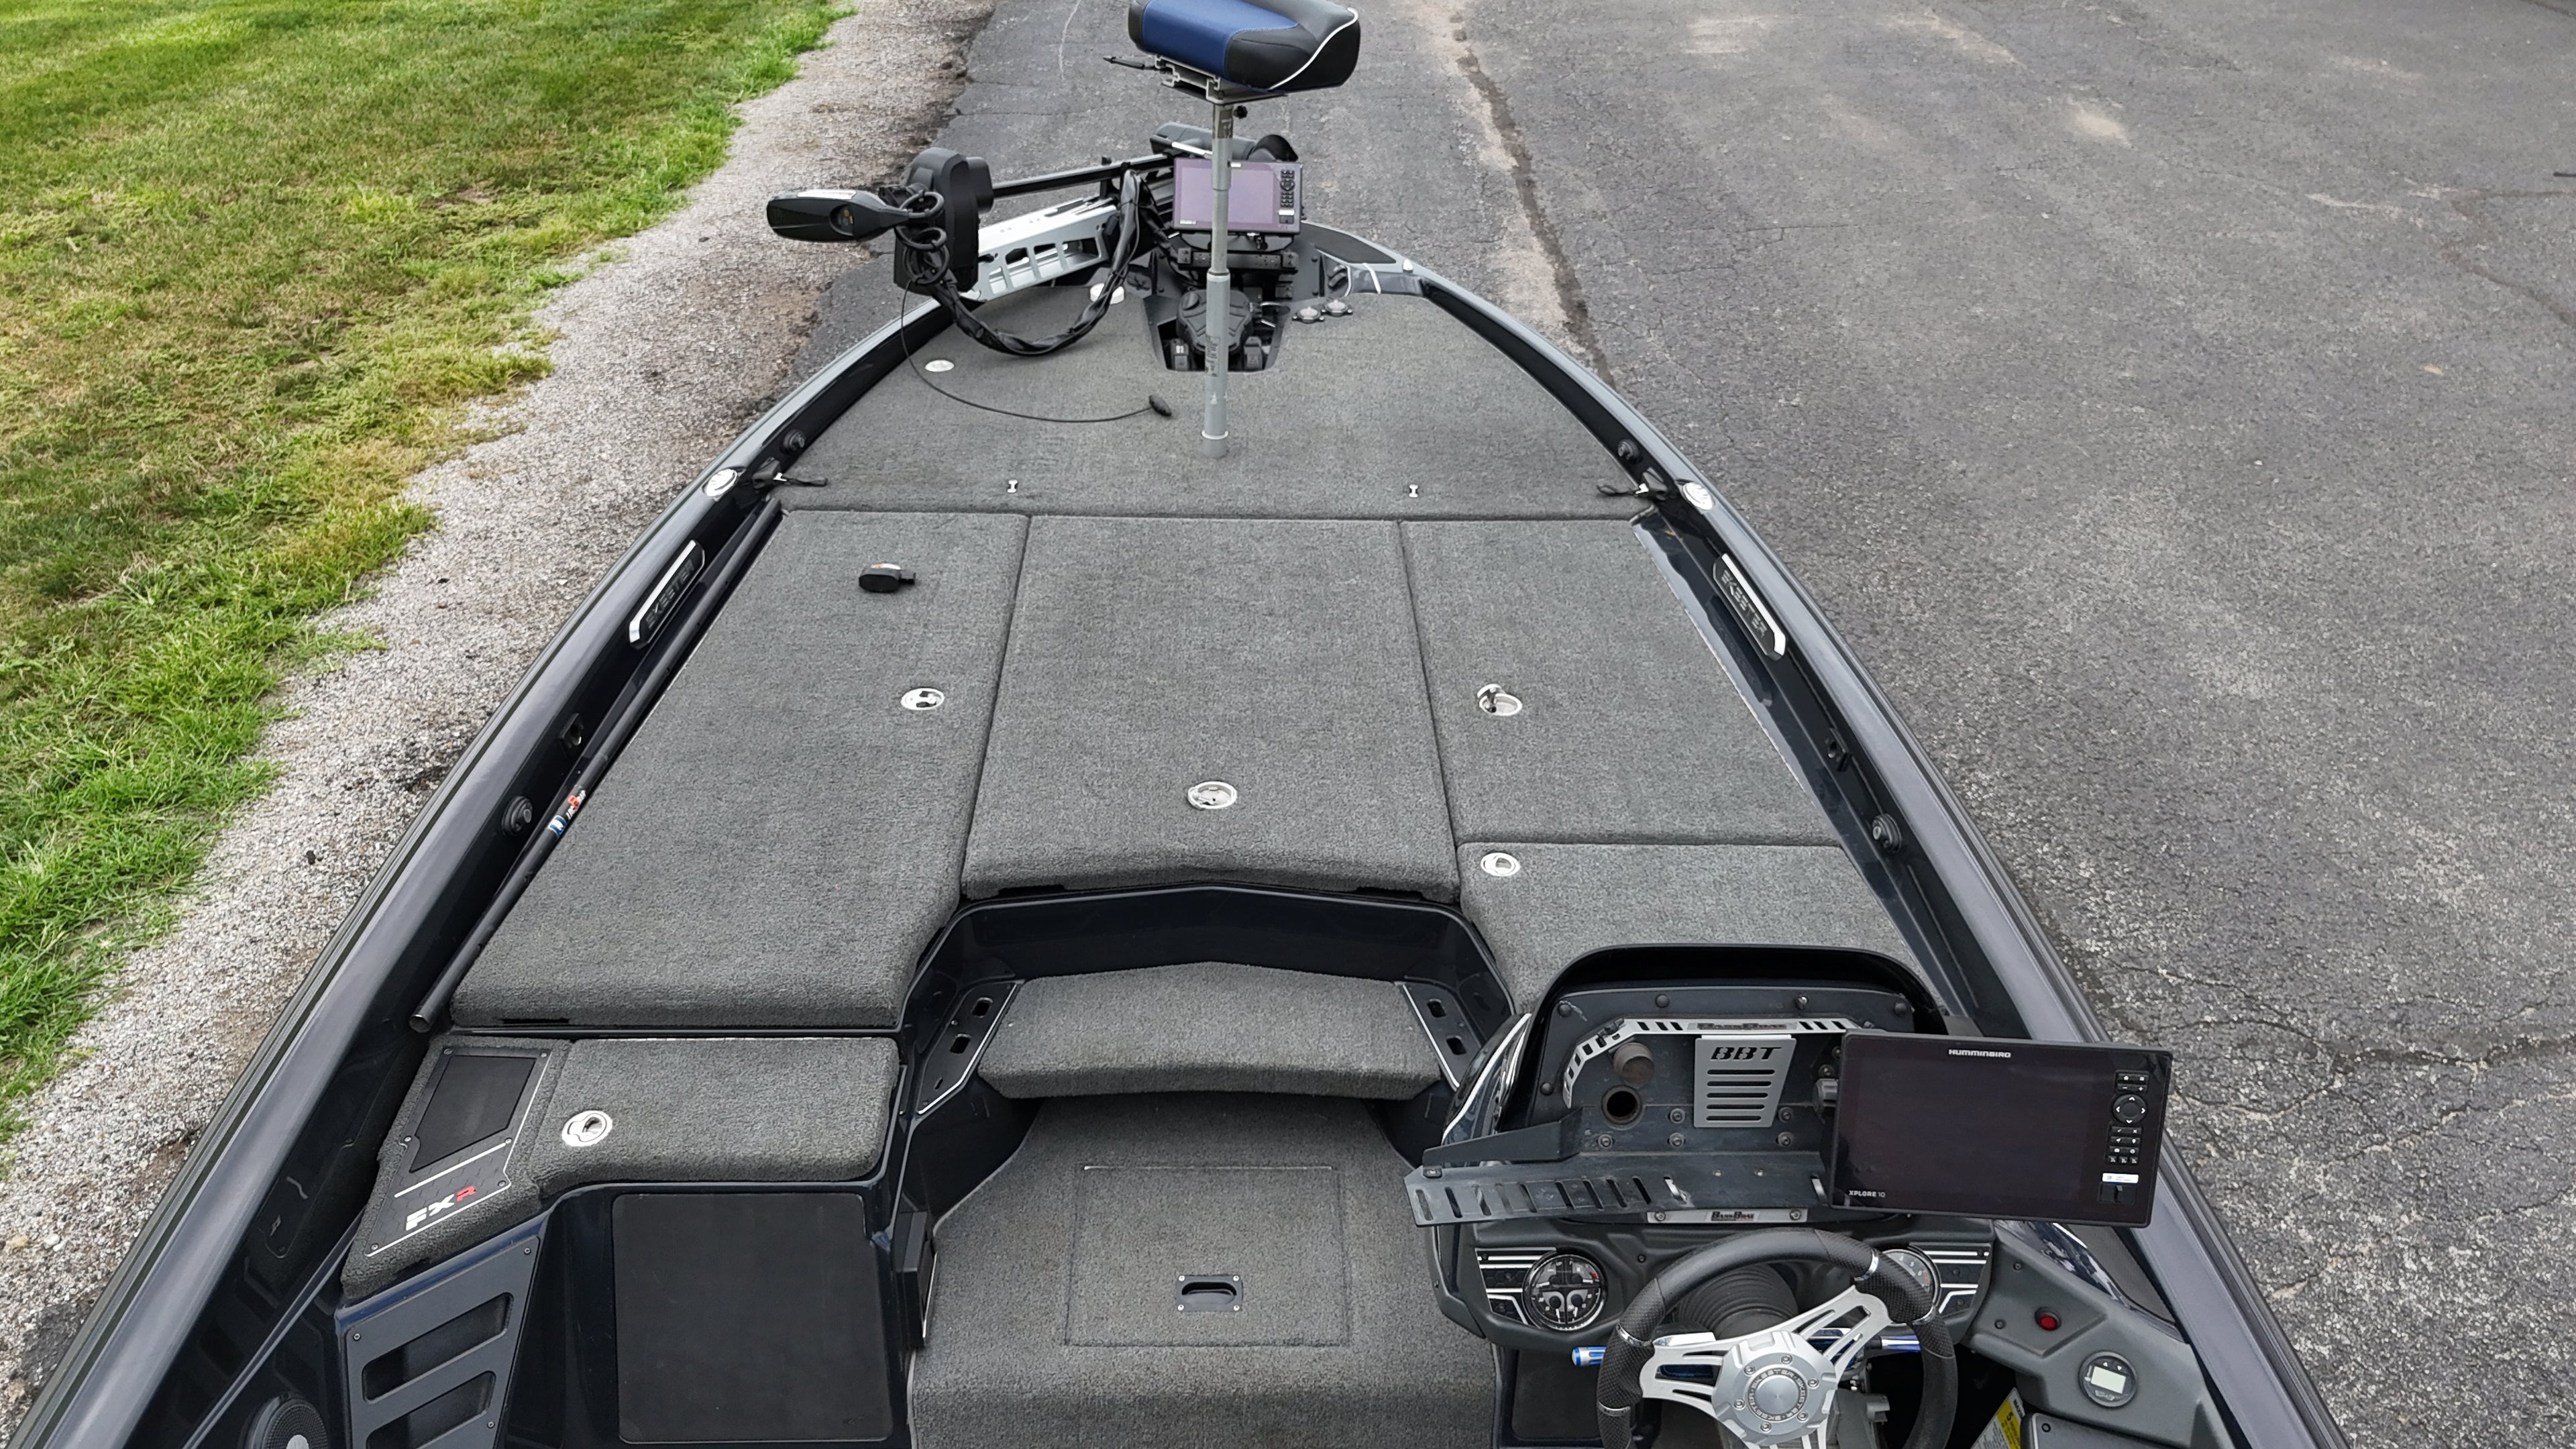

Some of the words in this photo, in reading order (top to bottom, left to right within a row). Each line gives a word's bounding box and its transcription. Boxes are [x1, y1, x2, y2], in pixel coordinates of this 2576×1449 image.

[645, 559, 695, 629] SKEETER
[1721, 570, 1768, 638] SKEETER
[1711, 1046, 1782, 1060] BBT
[1948, 1049, 2011, 1058] HUMMINBIRD
[406, 1185, 476, 1231] FXR
